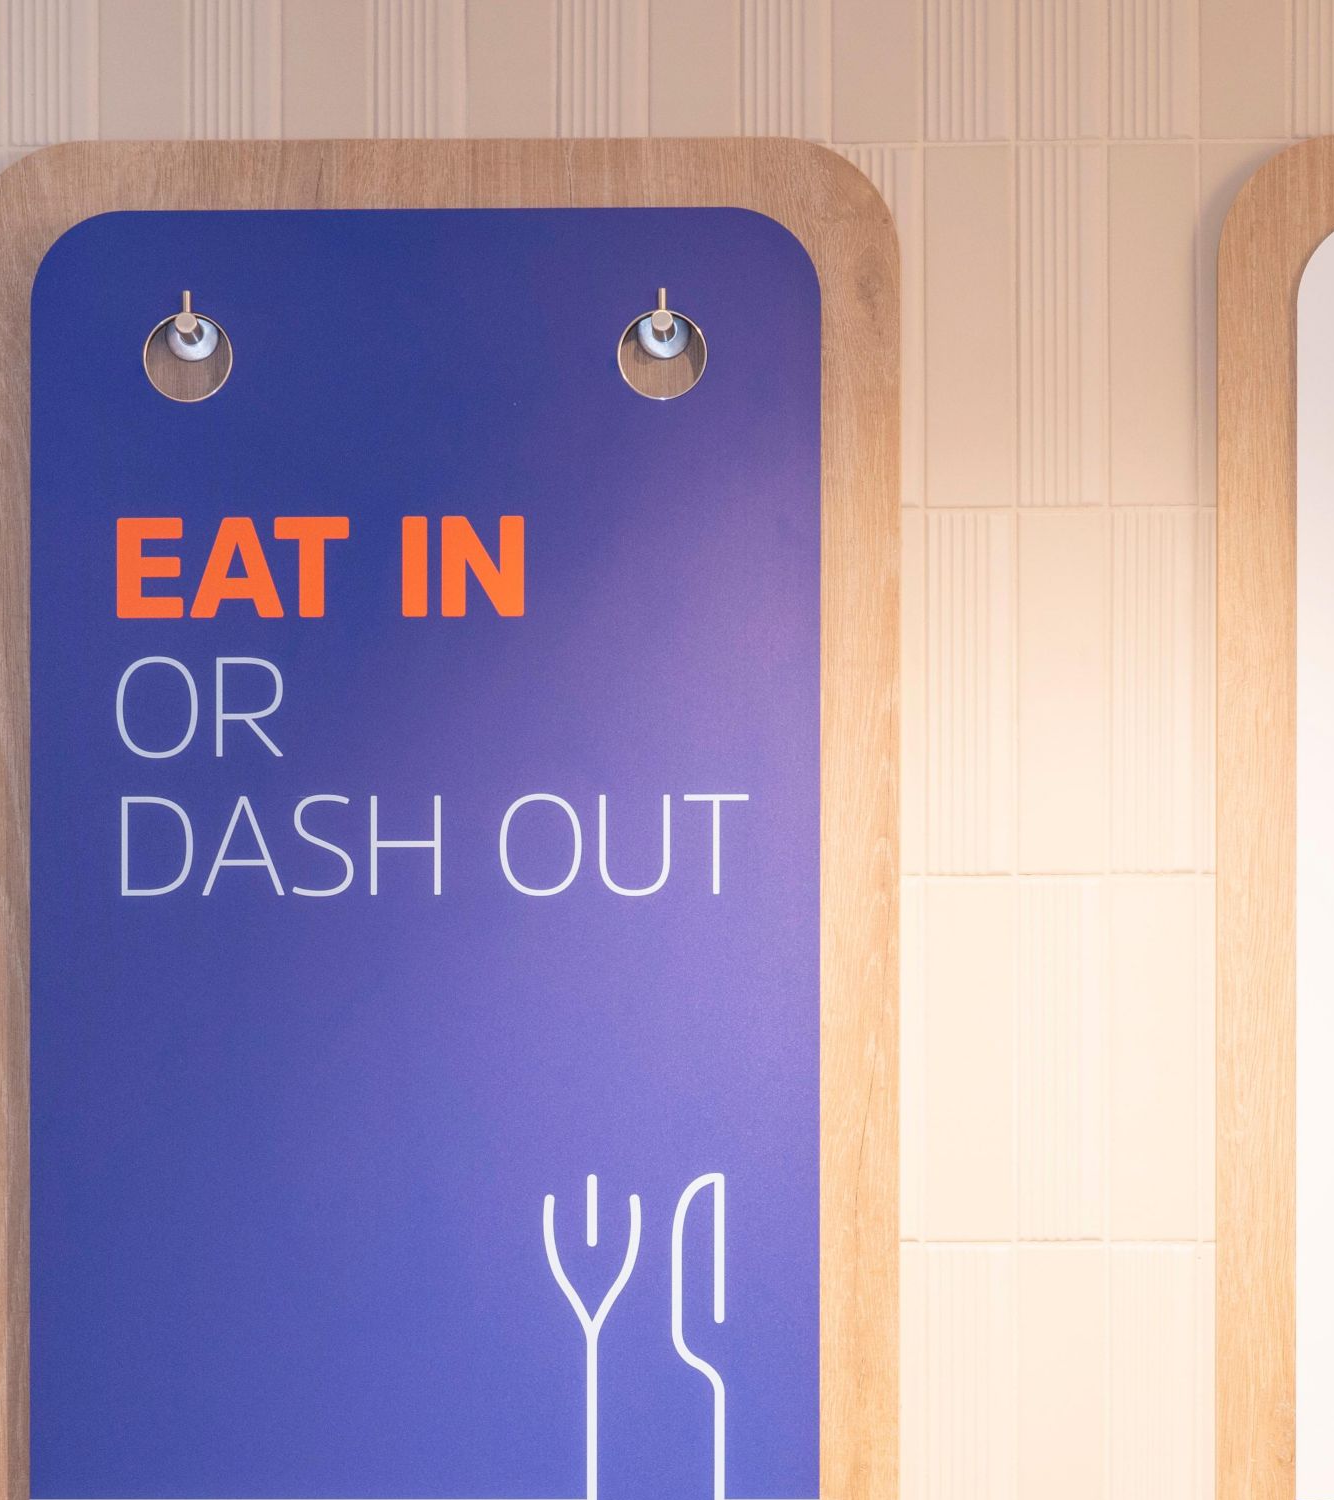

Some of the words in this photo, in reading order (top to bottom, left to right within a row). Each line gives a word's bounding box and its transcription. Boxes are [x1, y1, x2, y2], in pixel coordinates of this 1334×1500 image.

[116, 516, 350, 618] EAT
[402, 515, 525, 617] IN
[115, 656, 284, 759] OR
[120, 794, 442, 897] DASH
[499, 793, 750, 896] OUT
